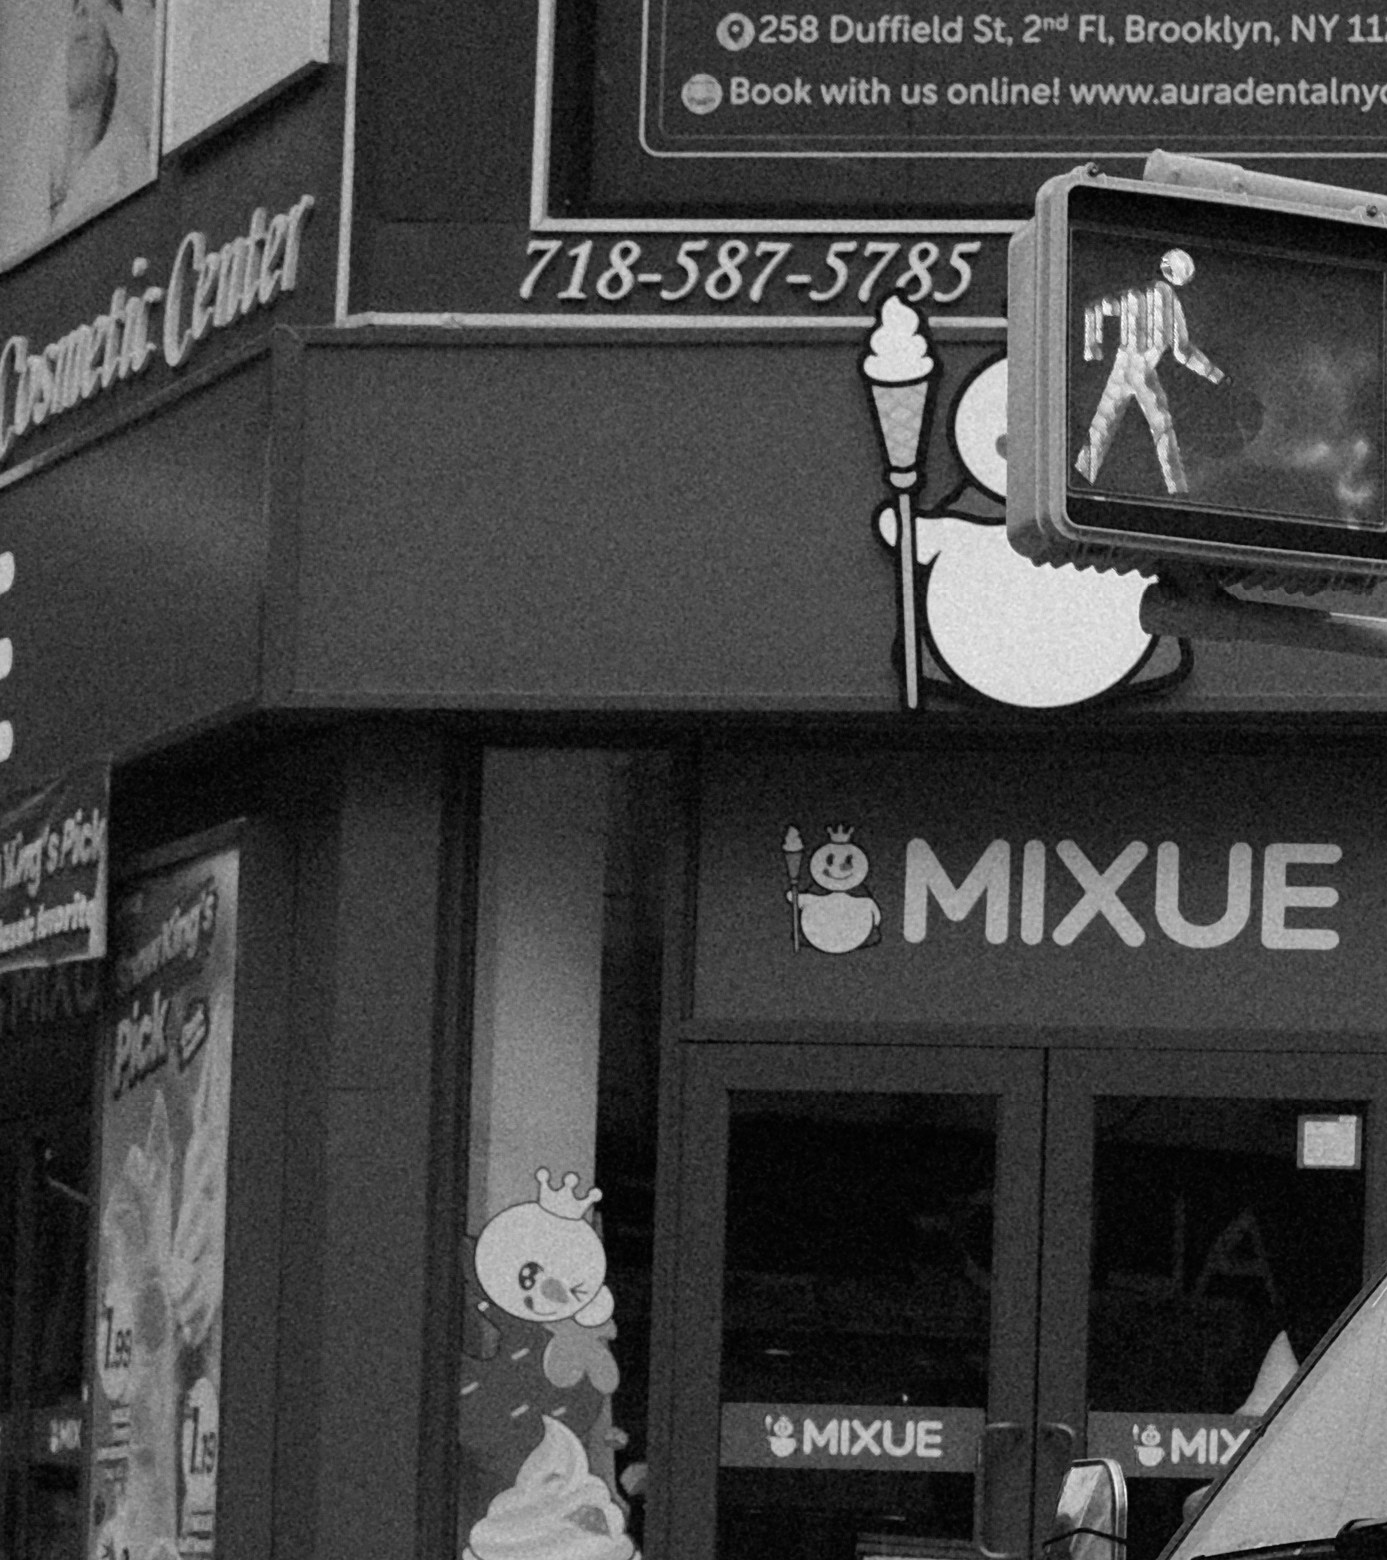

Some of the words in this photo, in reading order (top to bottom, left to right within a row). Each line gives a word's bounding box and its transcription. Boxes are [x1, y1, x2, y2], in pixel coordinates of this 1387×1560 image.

[759, 15, 818, 43] 258
[830, 15, 962, 43] Duffield
[974, 14, 1012, 45] St,
[1023, 14, 1068, 43] 2nd
[1079, 15, 1114, 44] Fl,
[1126, 15, 1280, 50] Brooklyn,
[1292, 15, 1339, 42] NY
[731, 77, 811, 104] Book
[821, 78, 890, 104] with
[902, 84, 937, 104] us
[947, 78, 1059, 104] online!
[520, 240, 980, 303] 718-587-5785
[0, 255, 163, 460] Cosmetic
[162, 192, 316, 368] Center
[903, 840, 1341, 950] MIXUE
[803, 1419, 942, 1457] MIXUE
